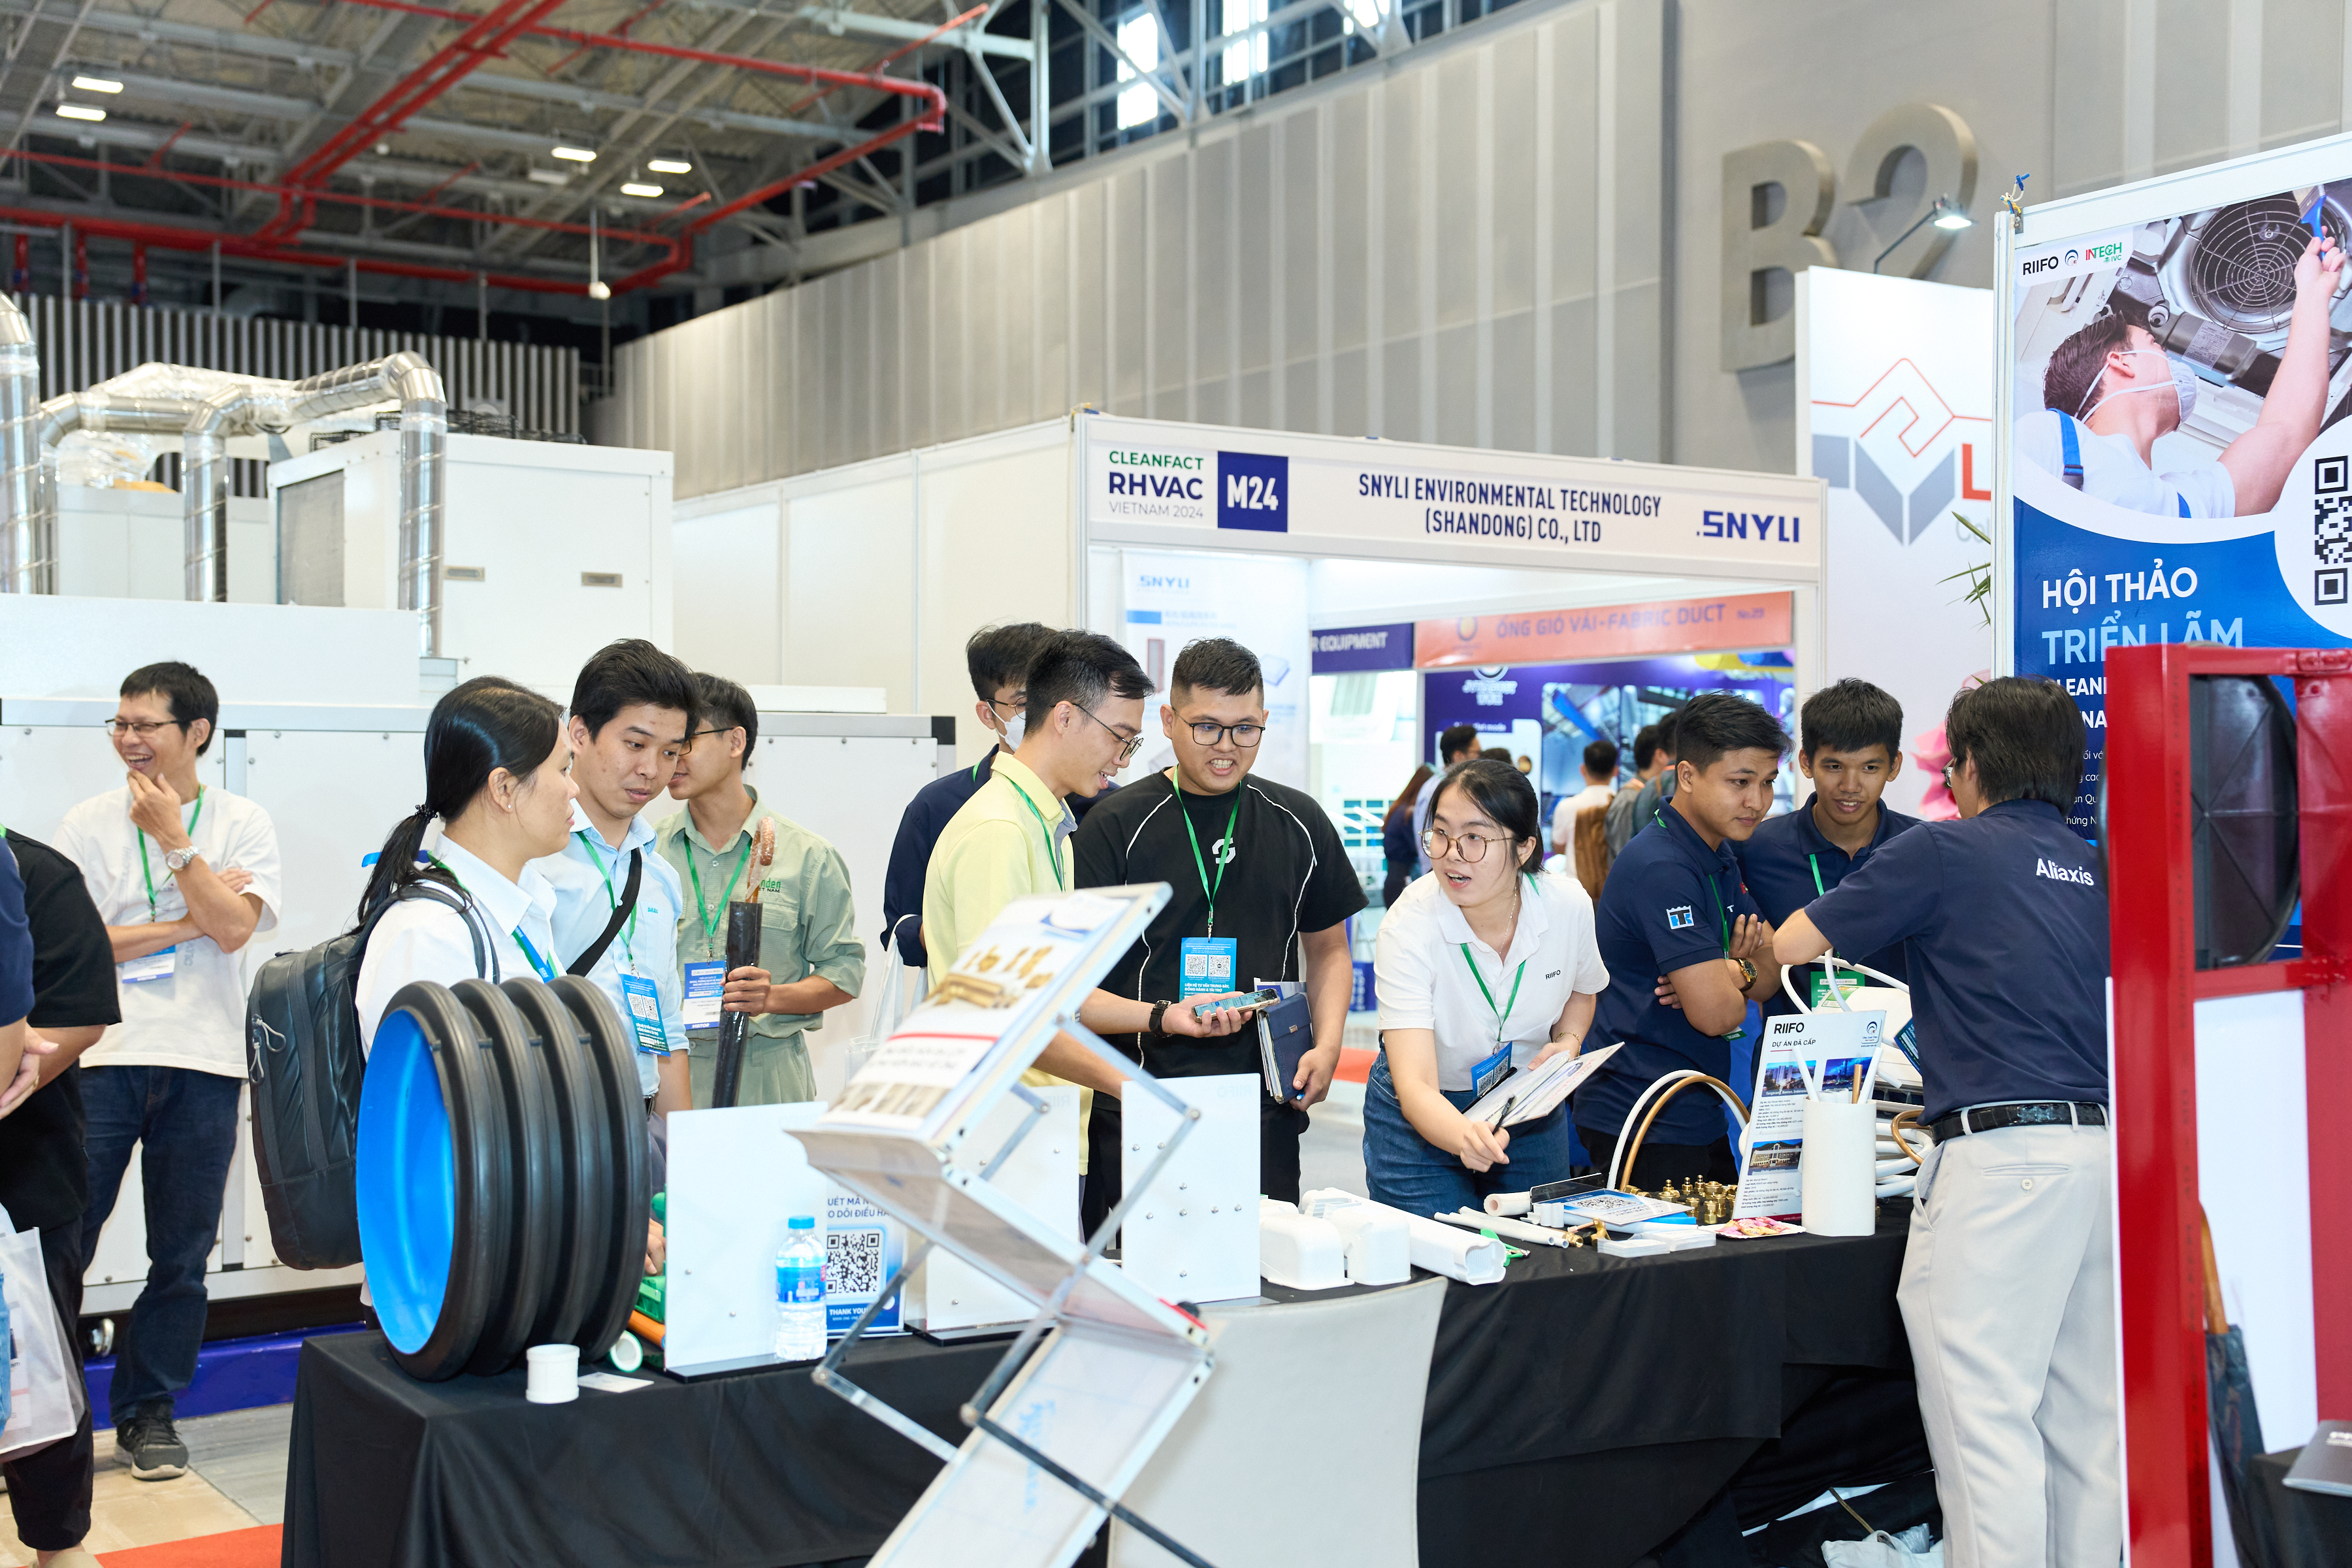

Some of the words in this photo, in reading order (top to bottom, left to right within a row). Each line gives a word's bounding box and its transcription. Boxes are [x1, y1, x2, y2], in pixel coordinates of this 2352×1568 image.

[1721, 102, 1978, 372] B2
[2085, 242, 2122, 261] INTECH
[2023, 256, 2059, 276] RIIFO
[1109, 451, 1203, 470] CLEANFACT
[1109, 472, 1203, 500] RHVAC
[1227, 474, 1279, 511] M24
[1359, 474, 1409, 500] SNYLI
[1415, 478, 1555, 510] ENVIRONMENTAL
[1560, 489, 1661, 517] TECHNOLOGY
[1109, 501, 1169, 517] VIETNAM
[1173, 505, 1203, 519] 2024
[1426, 508, 1533, 540] (SHANDONG)
[1537, 517, 1569, 544] CO.,
[1575, 521, 1601, 543] LTD
[2042, 568, 2096, 614] HỘI
[2105, 559, 2198, 604] THẢO
[1677, 604, 1726, 625] DUCT
[1320, 632, 1389, 653] EQUIPMENT
[2042, 610, 2146, 665] TRIỂN
[2057, 677, 2107, 696] EAN
[2036, 858, 2095, 886] Aliaxis
[760, 877, 781, 889] nden
[1545, 970, 1561, 980] RIIFO
[1774, 1022, 1805, 1034] RIIFO
[828, 1196, 845, 1206] UÉT
[837, 1207, 853, 1218] DÕI
